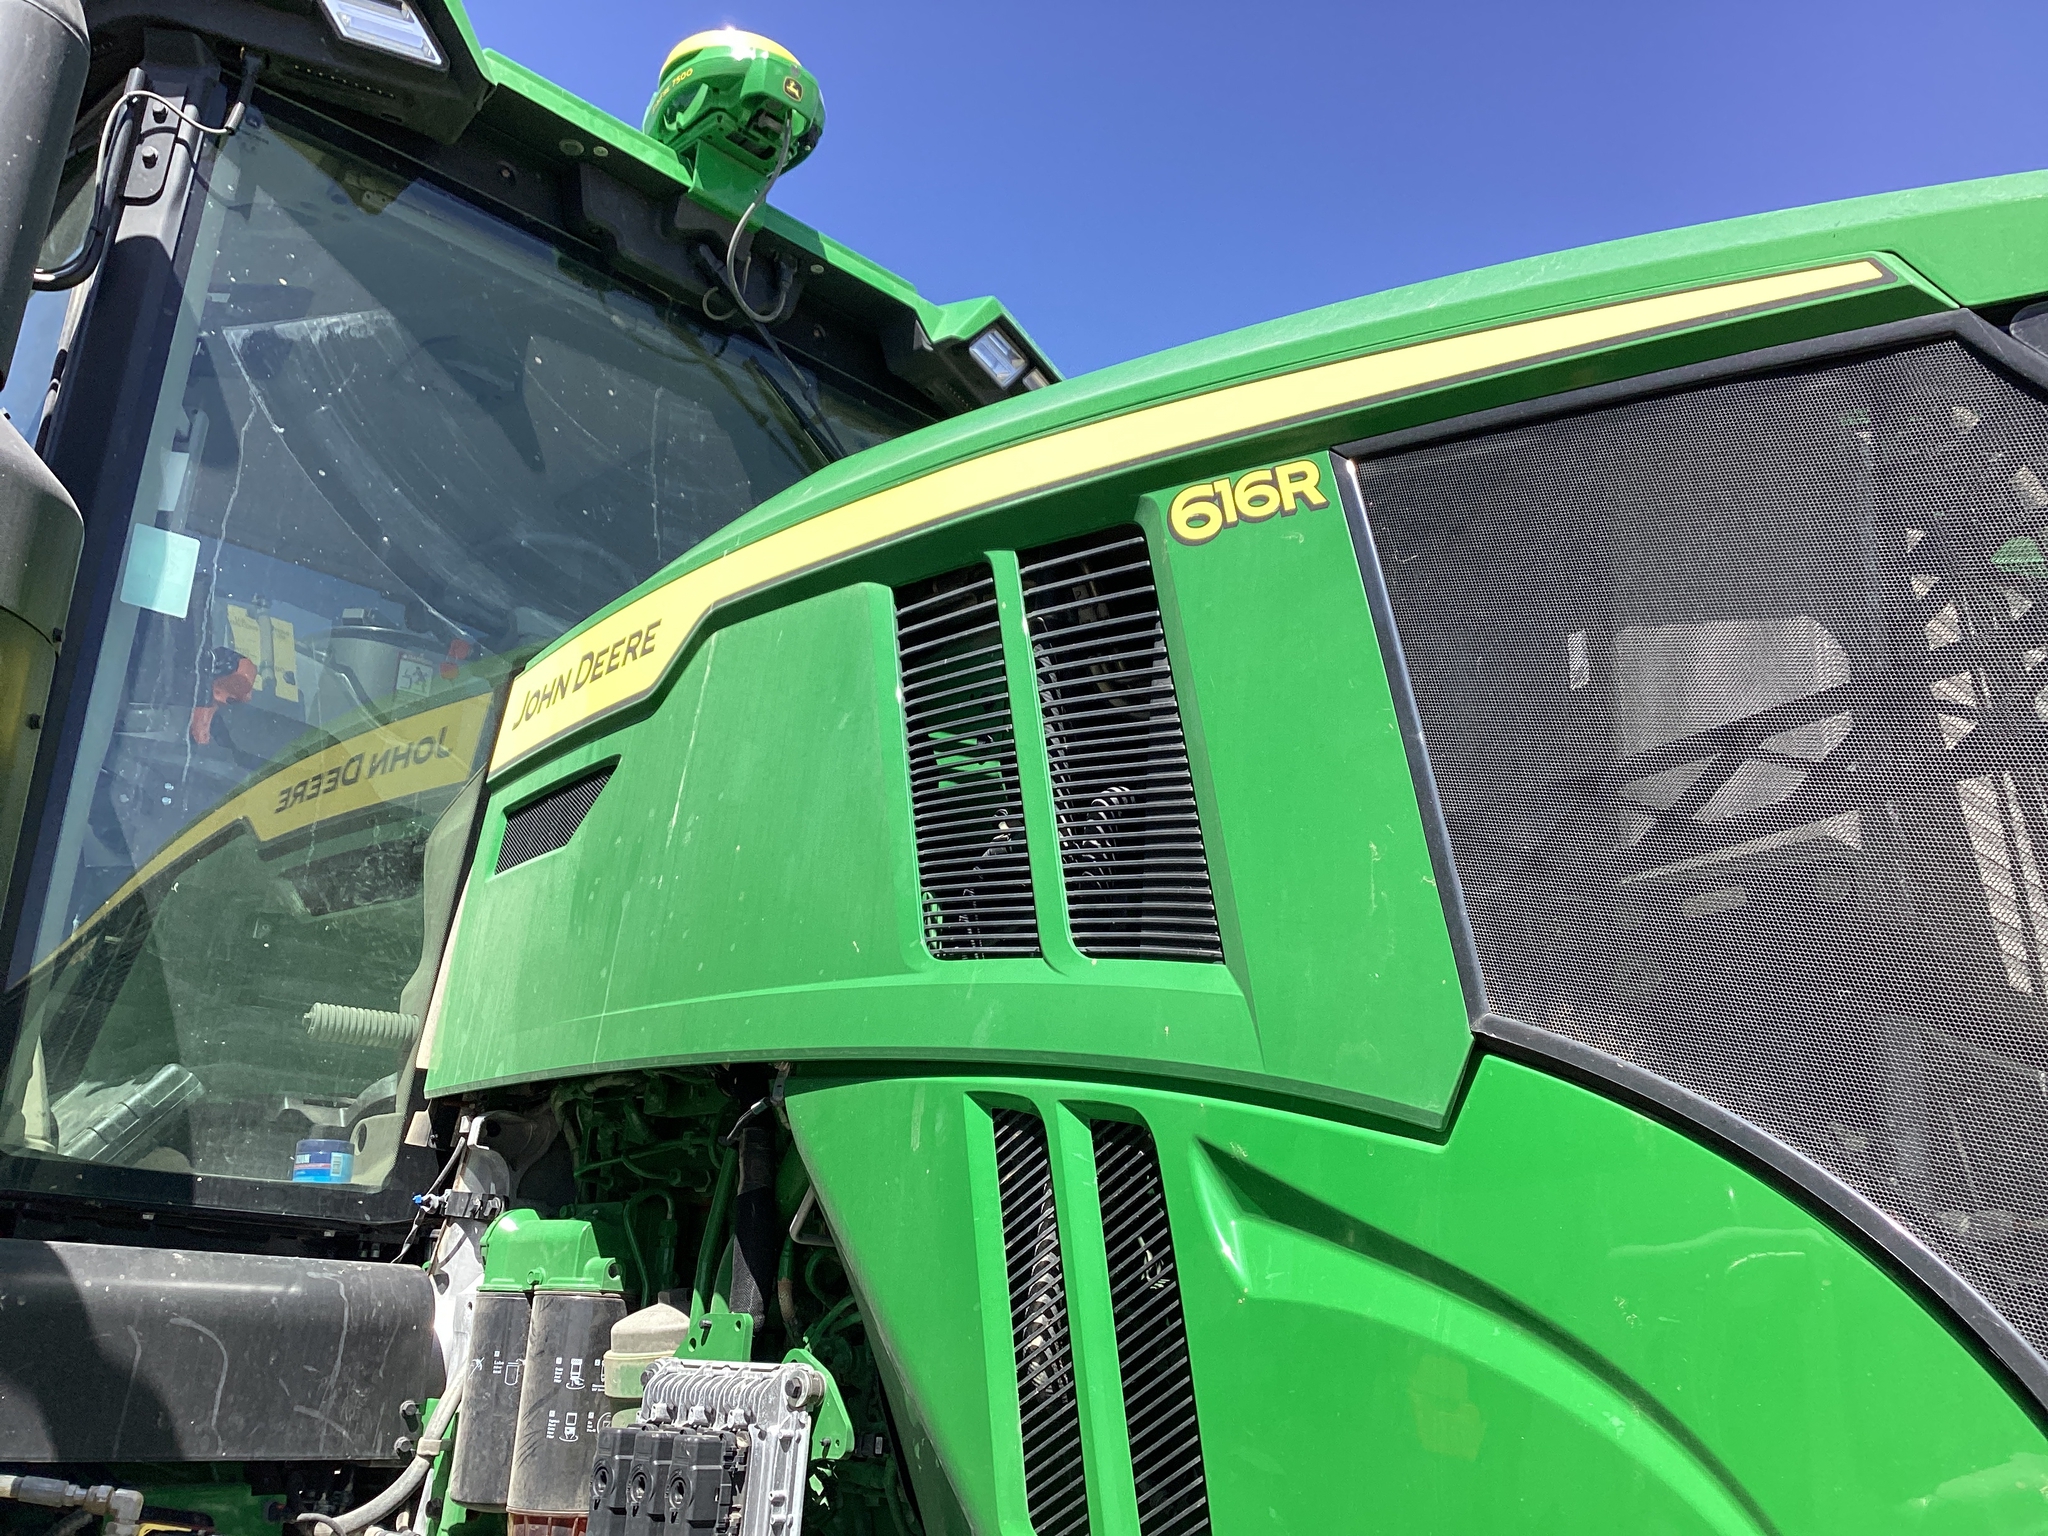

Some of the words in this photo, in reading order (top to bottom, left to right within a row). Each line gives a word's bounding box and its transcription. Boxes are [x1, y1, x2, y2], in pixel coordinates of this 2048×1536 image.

[672, 67, 693, 87] 7500
[1167, 459, 1330, 546] 616R
[511, 668, 573, 731] JOHN
[572, 618, 662, 693] DEERE
